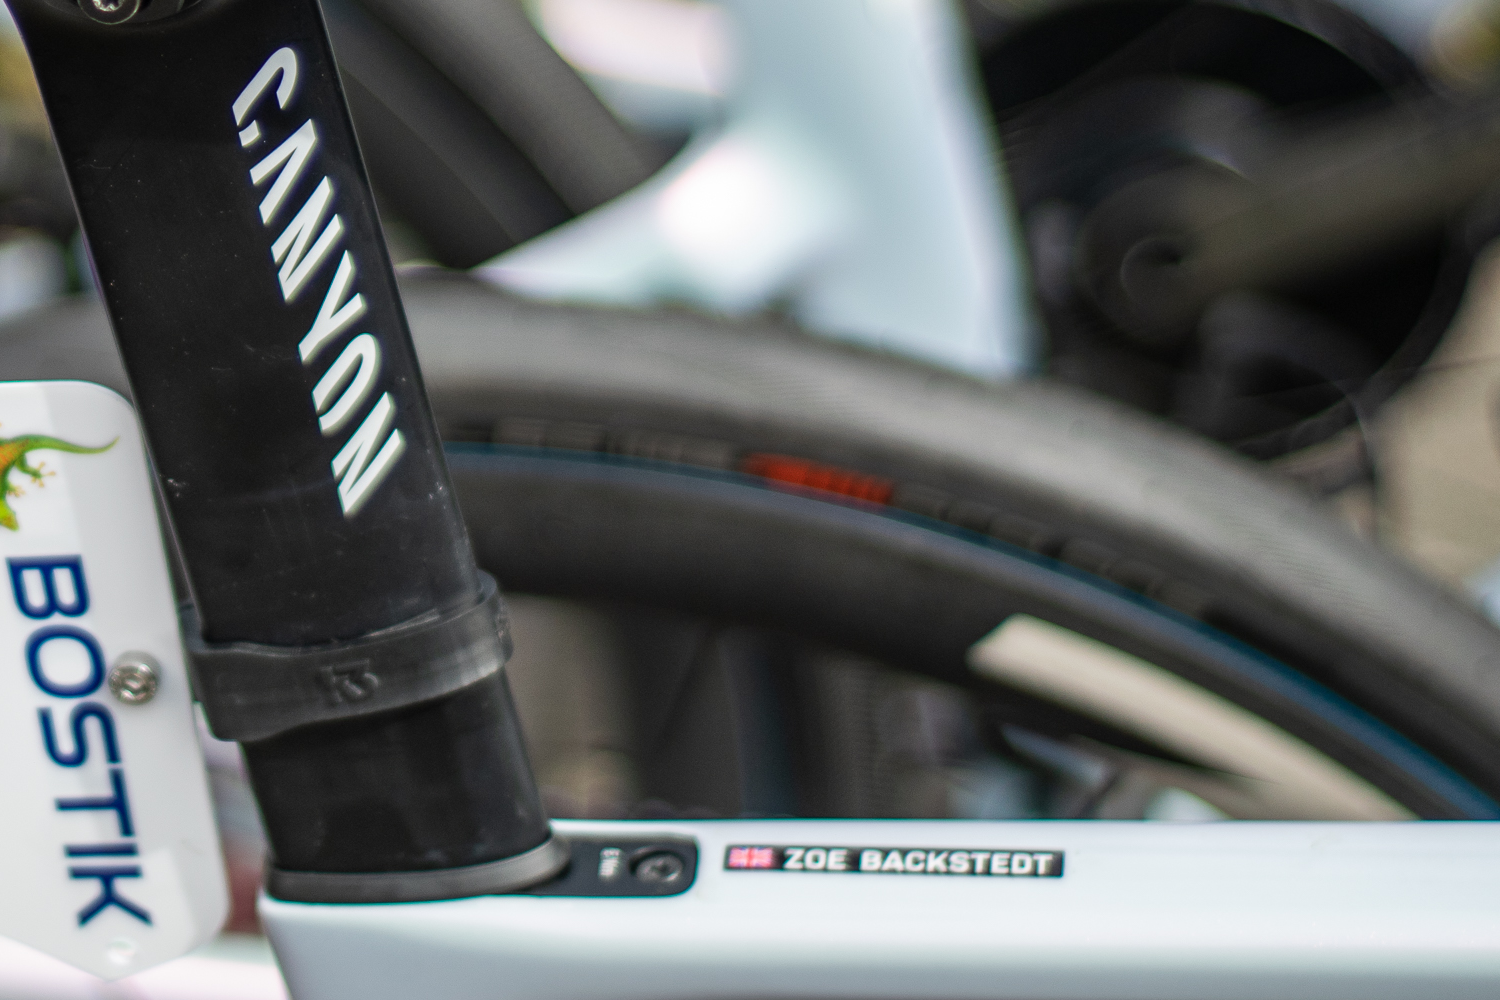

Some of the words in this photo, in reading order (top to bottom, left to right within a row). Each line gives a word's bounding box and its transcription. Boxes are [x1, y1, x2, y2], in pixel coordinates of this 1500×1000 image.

[232, 46, 405, 517] CANYON
[5, 554, 155, 929] BOSTIK
[783, 847, 849, 872] ZOE
[859, 848, 1054, 876] BACKSTEDT
